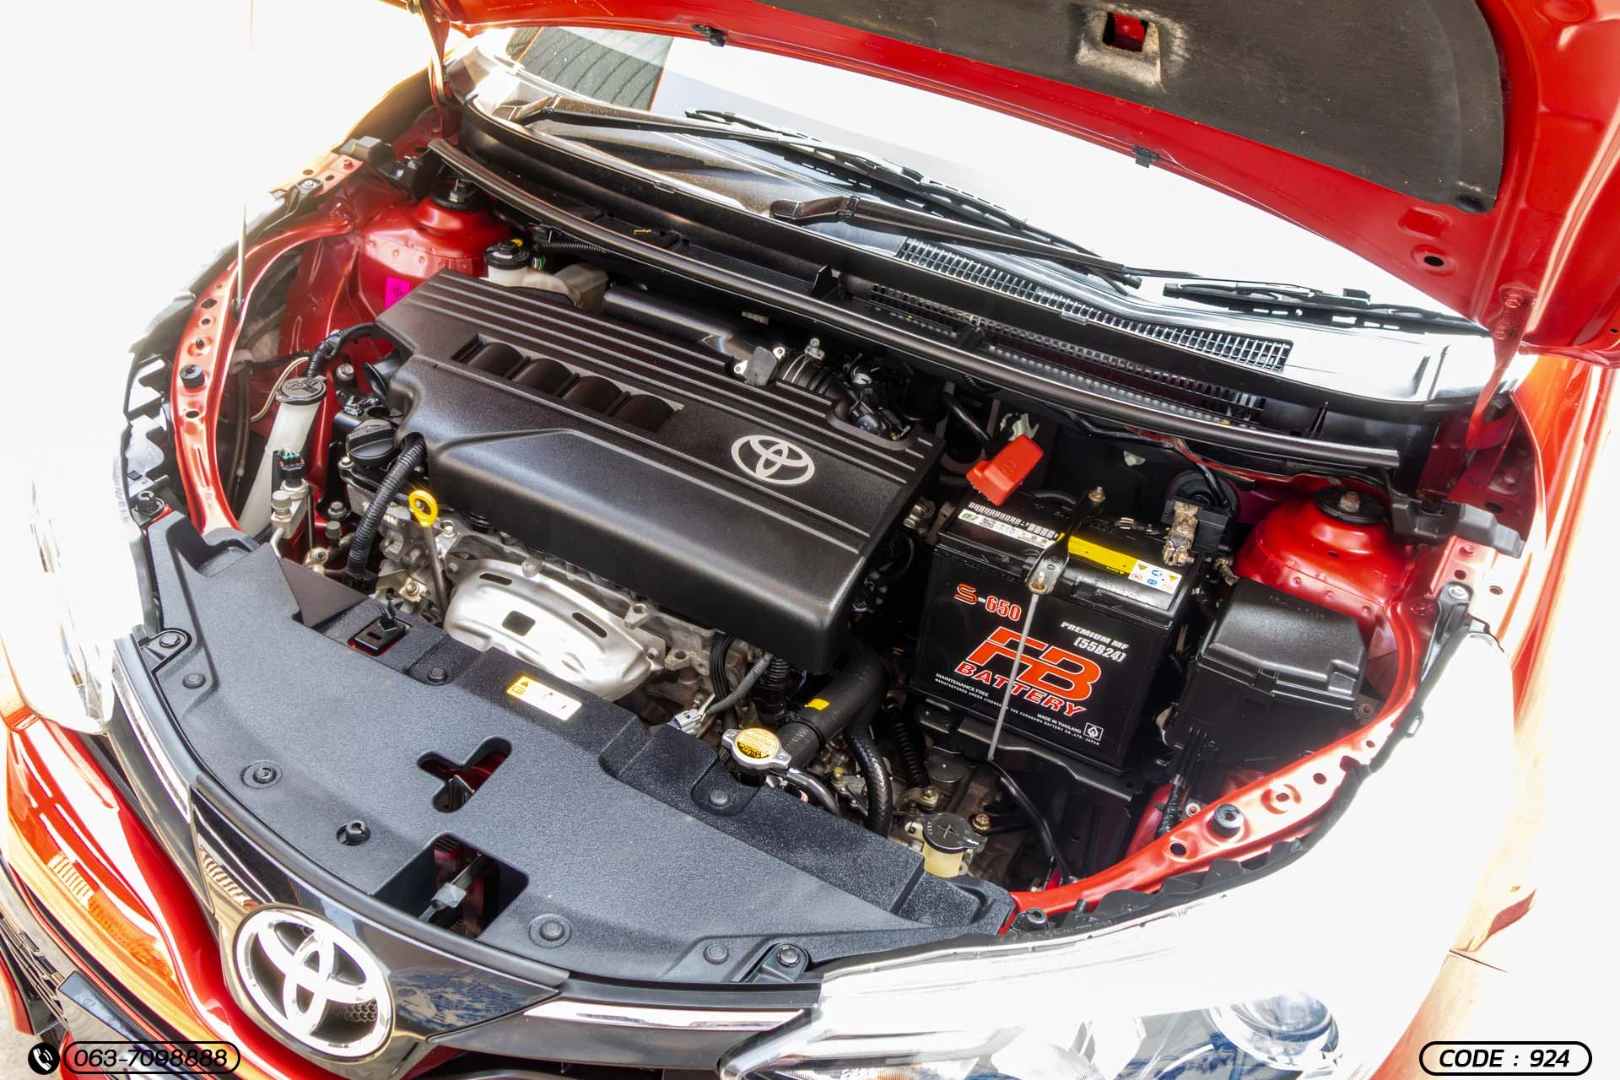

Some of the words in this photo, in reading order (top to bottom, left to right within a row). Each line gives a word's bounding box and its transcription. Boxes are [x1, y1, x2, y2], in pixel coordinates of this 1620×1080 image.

[953, 583, 1022, 622] S-650
[1060, 621, 1111, 645] PREMIUM
[1110, 639, 1130, 650] MF
[965, 626, 1102, 701] FB
[935, 673, 975, 692] MAINTENANCE
[975, 688, 989, 697] FREE
[954, 661, 1088, 717] BATTERY
[1037, 713, 1051, 721] MADE
[1057, 720, 1082, 734] THAILAND
